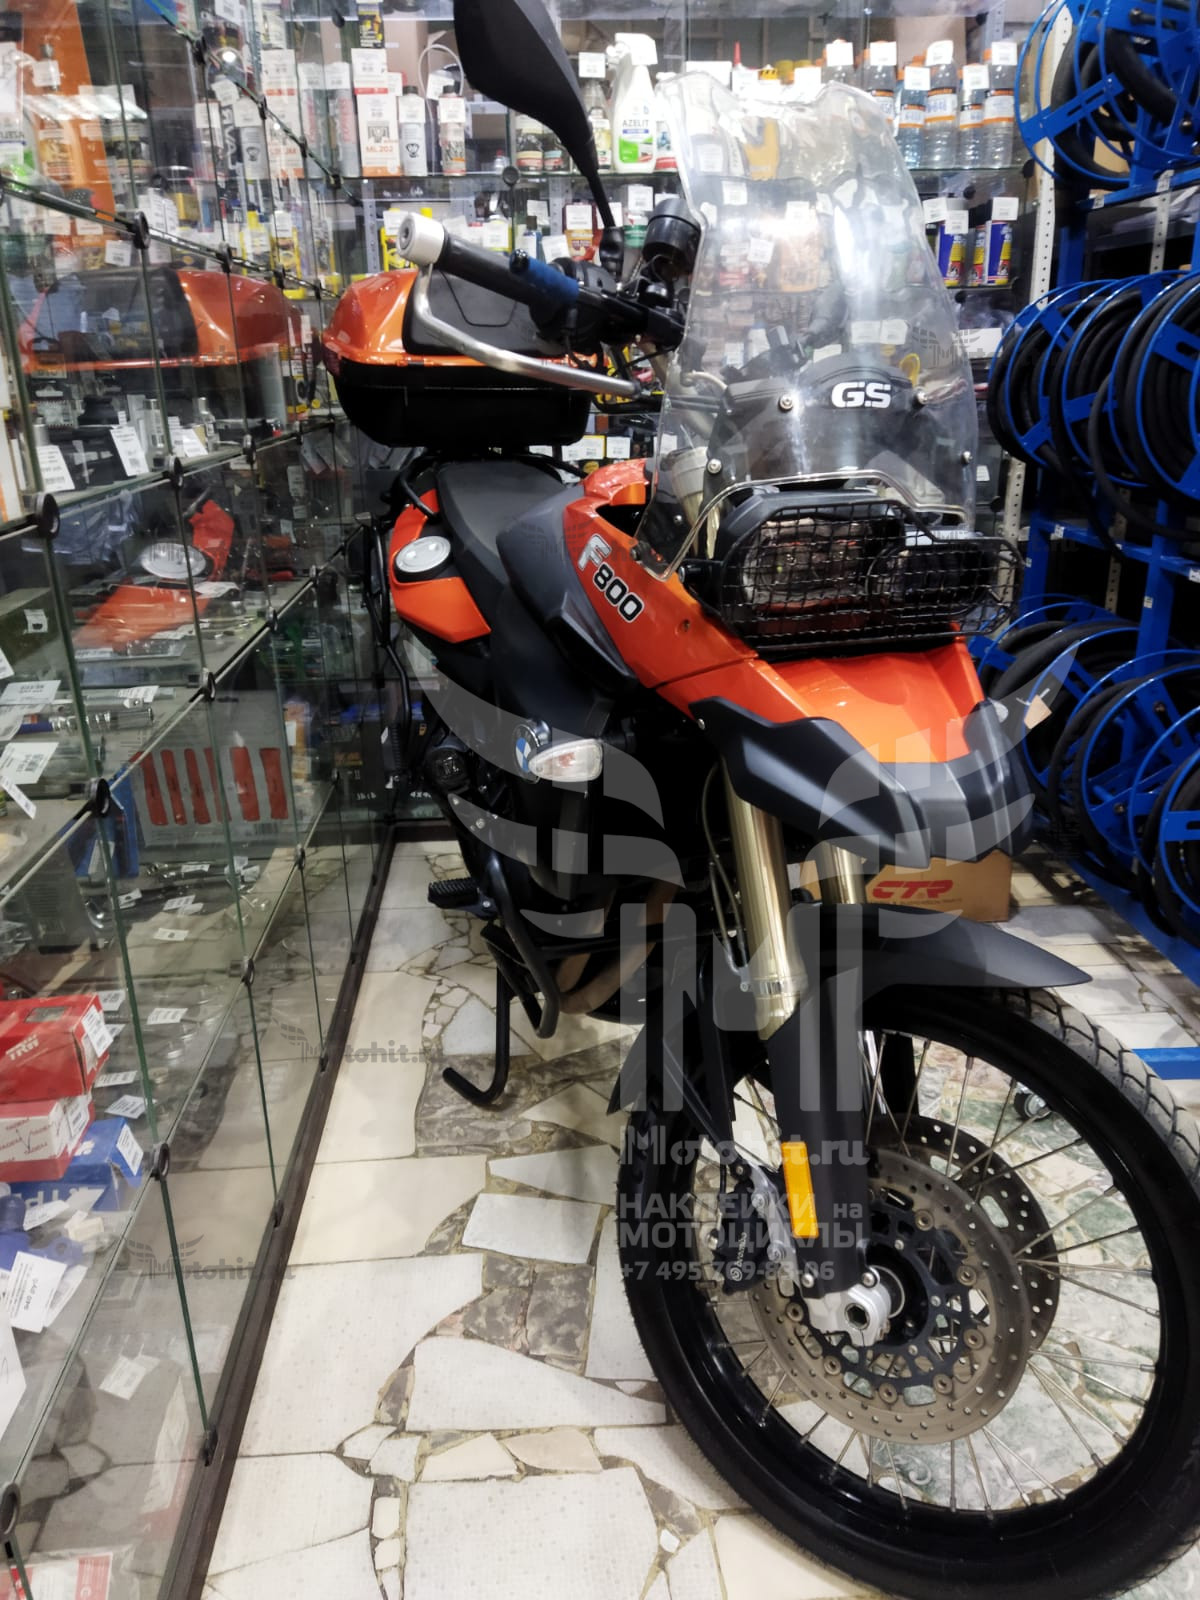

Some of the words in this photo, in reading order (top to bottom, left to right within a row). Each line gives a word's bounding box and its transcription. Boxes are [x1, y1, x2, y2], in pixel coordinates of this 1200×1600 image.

[622, 119, 649, 127] AZELIT
[831, 381, 892, 409] GS
[578, 533, 612, 571] F
[593, 561, 645, 623] 800
[5, 1033, 39, 1061] TRW
